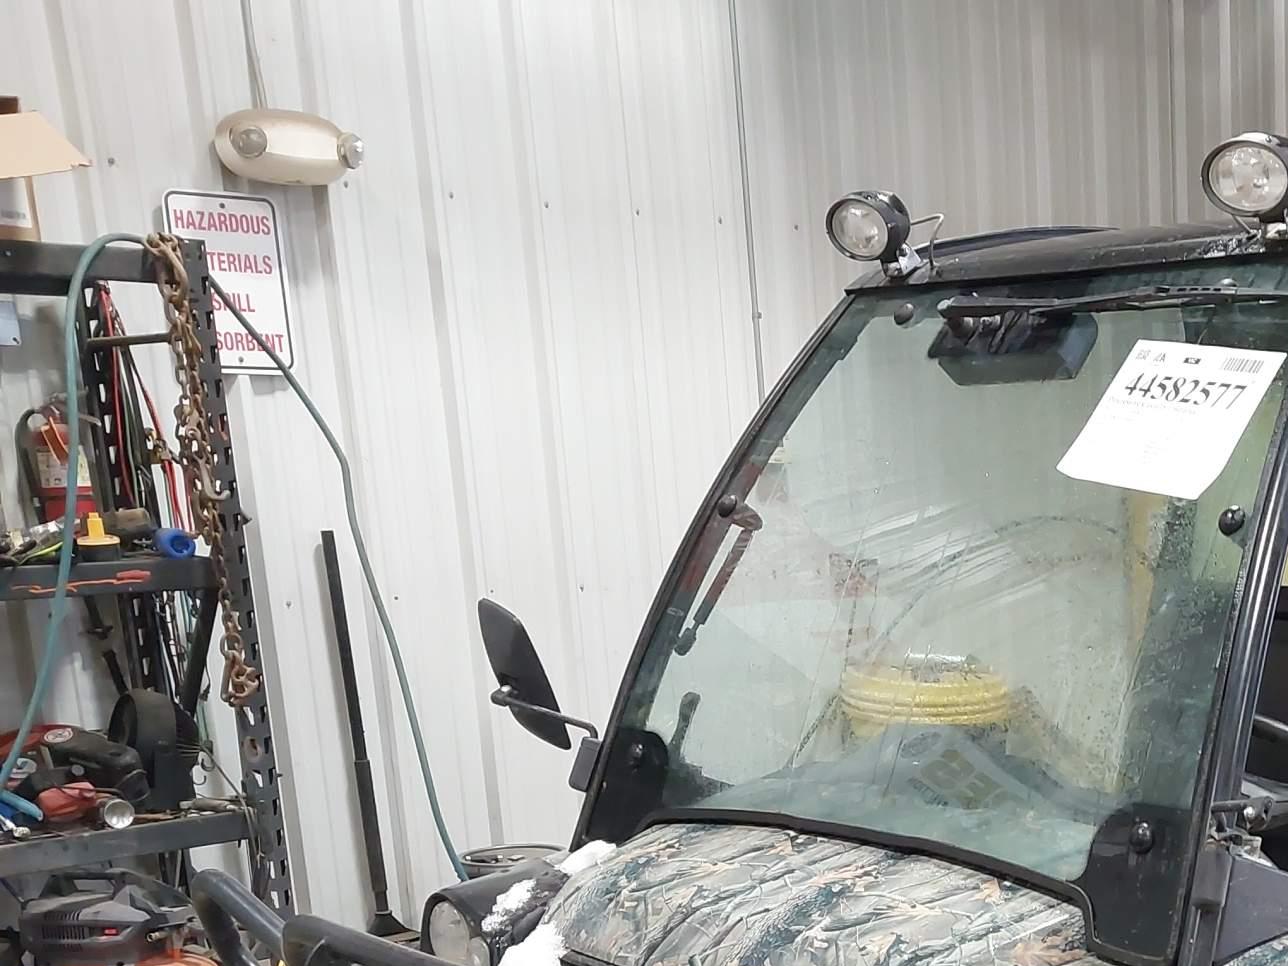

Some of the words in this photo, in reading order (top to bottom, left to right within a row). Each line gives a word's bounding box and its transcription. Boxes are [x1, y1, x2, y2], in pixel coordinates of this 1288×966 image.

[173, 209, 271, 235] HAZARDOUS
[207, 251, 273, 275] TERIALS
[215, 330, 284, 353] SORBNT
[1125, 373, 1247, 410] 44582577
